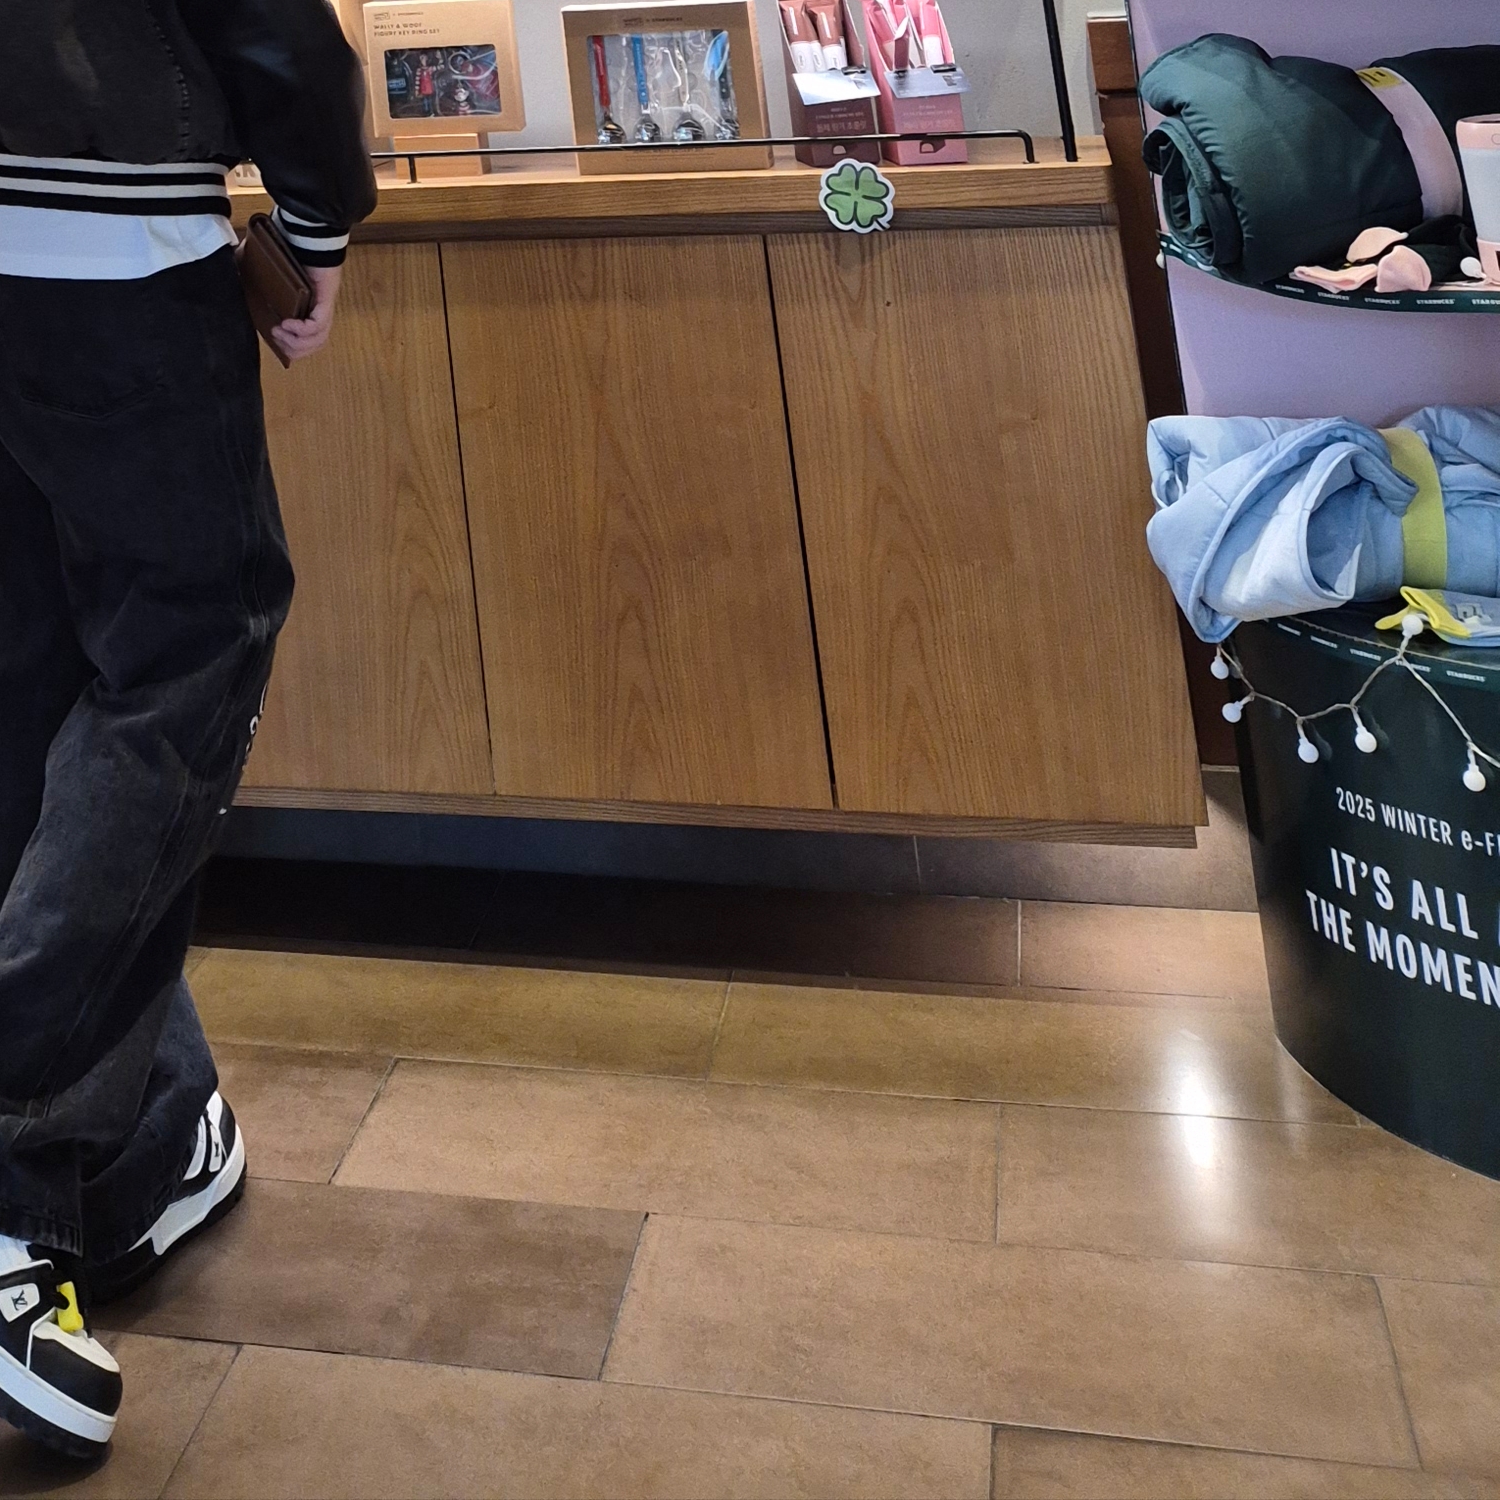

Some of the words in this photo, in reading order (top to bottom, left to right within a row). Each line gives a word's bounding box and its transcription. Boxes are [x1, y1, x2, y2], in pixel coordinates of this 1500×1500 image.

[1336, 786, 1376, 822] 2025
[1380, 802, 1454, 847] WINTER
[1461, 829, 1500, 856] e-F
[1305, 889, 1356, 953] THE
[1330, 846, 1395, 911] IT'S
[1411, 879, 1479, 940] ALL
